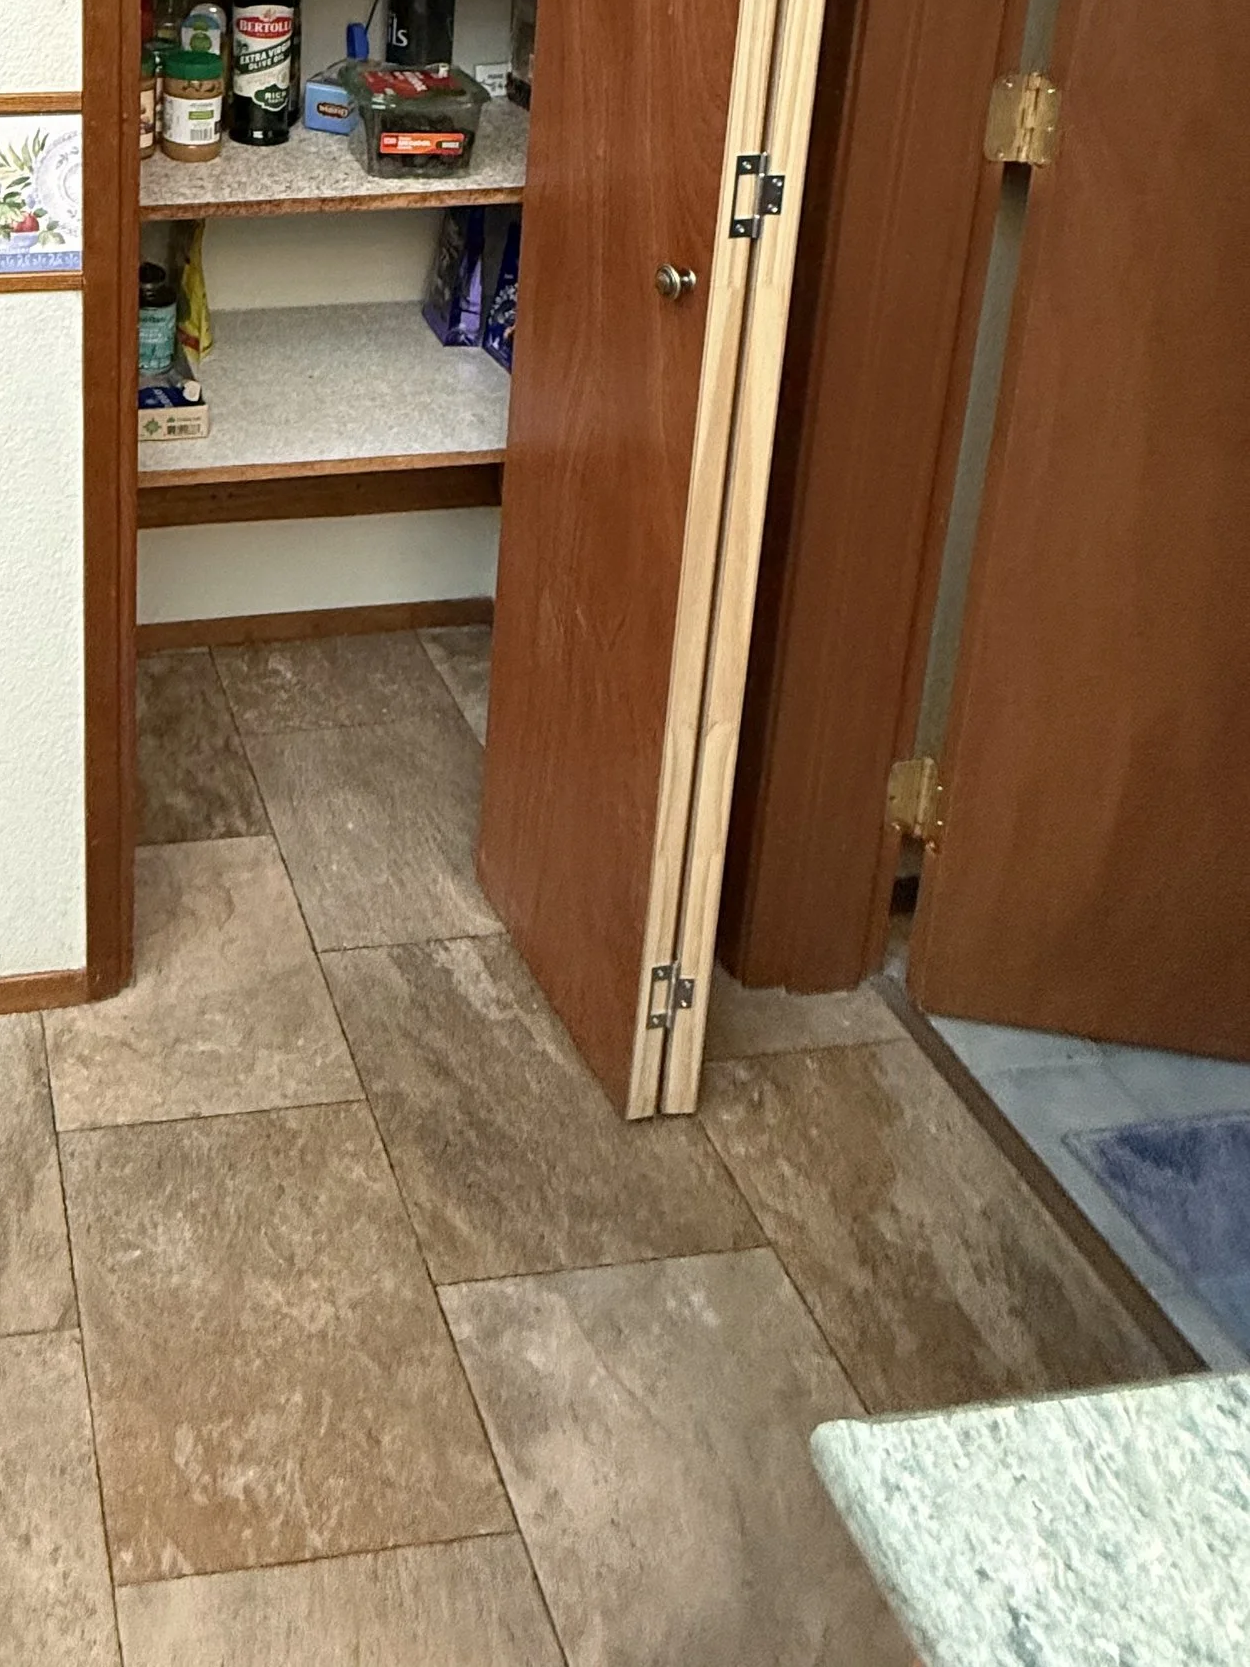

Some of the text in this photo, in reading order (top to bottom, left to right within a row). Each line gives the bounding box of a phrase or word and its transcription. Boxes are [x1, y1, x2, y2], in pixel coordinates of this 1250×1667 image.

[388, 13, 409, 48] ils
[239, 49, 267, 65] EXTRA
[248, 57, 272, 71] OLIVE
